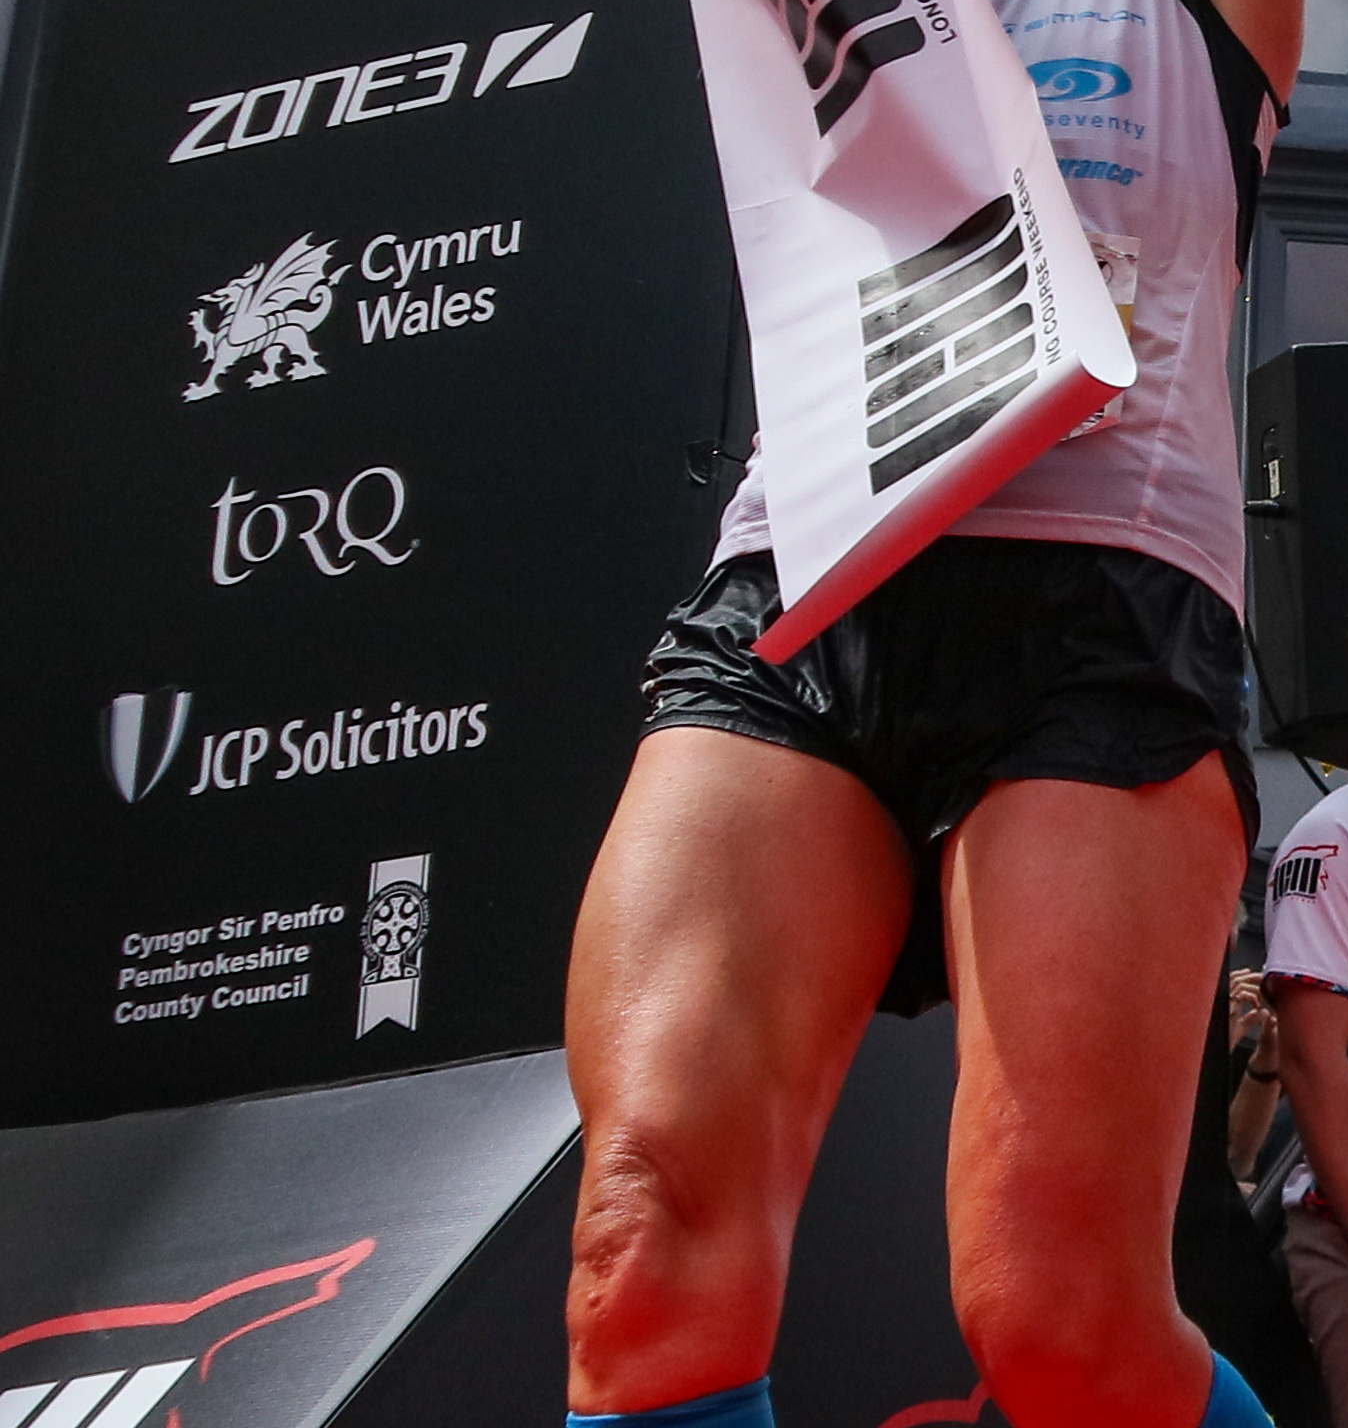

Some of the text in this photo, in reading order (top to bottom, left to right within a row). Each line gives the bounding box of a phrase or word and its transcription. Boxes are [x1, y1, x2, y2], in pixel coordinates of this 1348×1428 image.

[1045, 113, 1146, 140] seventy
[1013, 167, 1044, 259] WEEKEND
[360, 219, 522, 291] Cymru
[356, 283, 496, 344] Wales
[1035, 256, 1057, 336] COURSE
[189, 702, 489, 797] JCP Solicitors
[121, 925, 210, 961] Cyngor
[219, 915, 254, 941] Sir
[259, 901, 345, 934] Penfro
[117, 941, 311, 990] Pembrokeshire
[113, 974, 310, 1026] County Council
